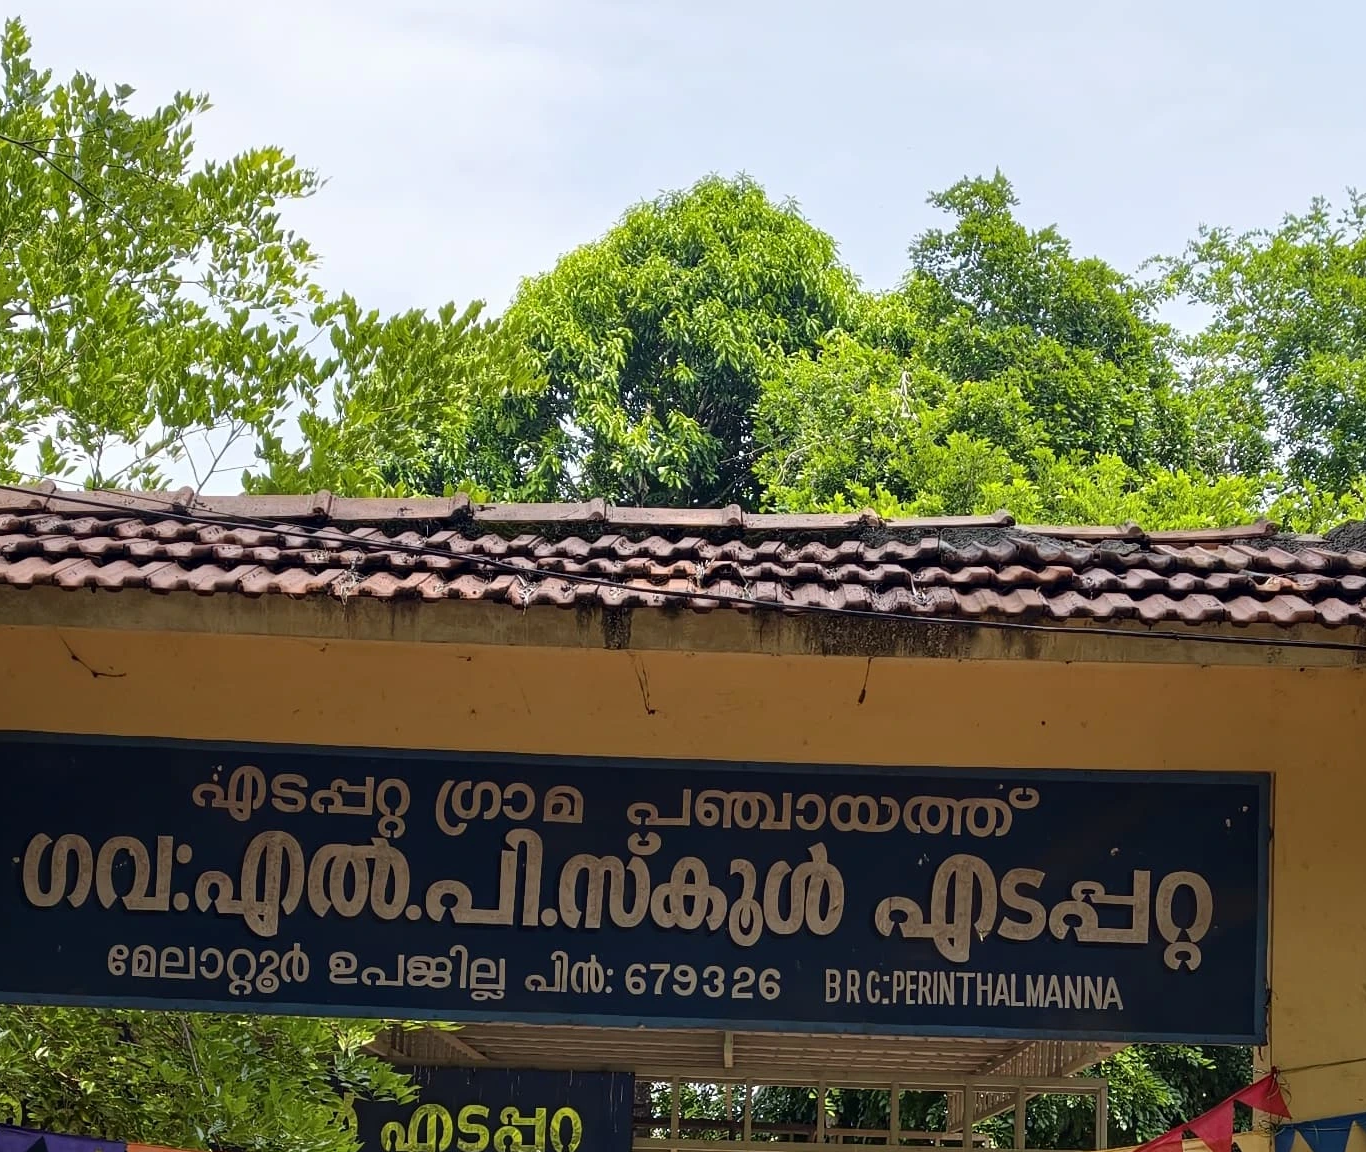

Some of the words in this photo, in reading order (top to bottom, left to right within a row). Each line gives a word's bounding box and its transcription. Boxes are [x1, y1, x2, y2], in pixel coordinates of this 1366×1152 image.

[192, 765, 410, 838] എടപ്പറ്റ
[435, 779, 584, 836] ഗ്രാമ
[626, 787, 1040, 838] പഞ്ചായത്ത്
[875, 853, 1213, 971] എടപ്പറ്റ
[107, 942, 310, 996] മേലാറ്റൂർ
[328, 944, 507, 1001] ഉപജില്ല
[624, 963, 782, 1001] 679326
